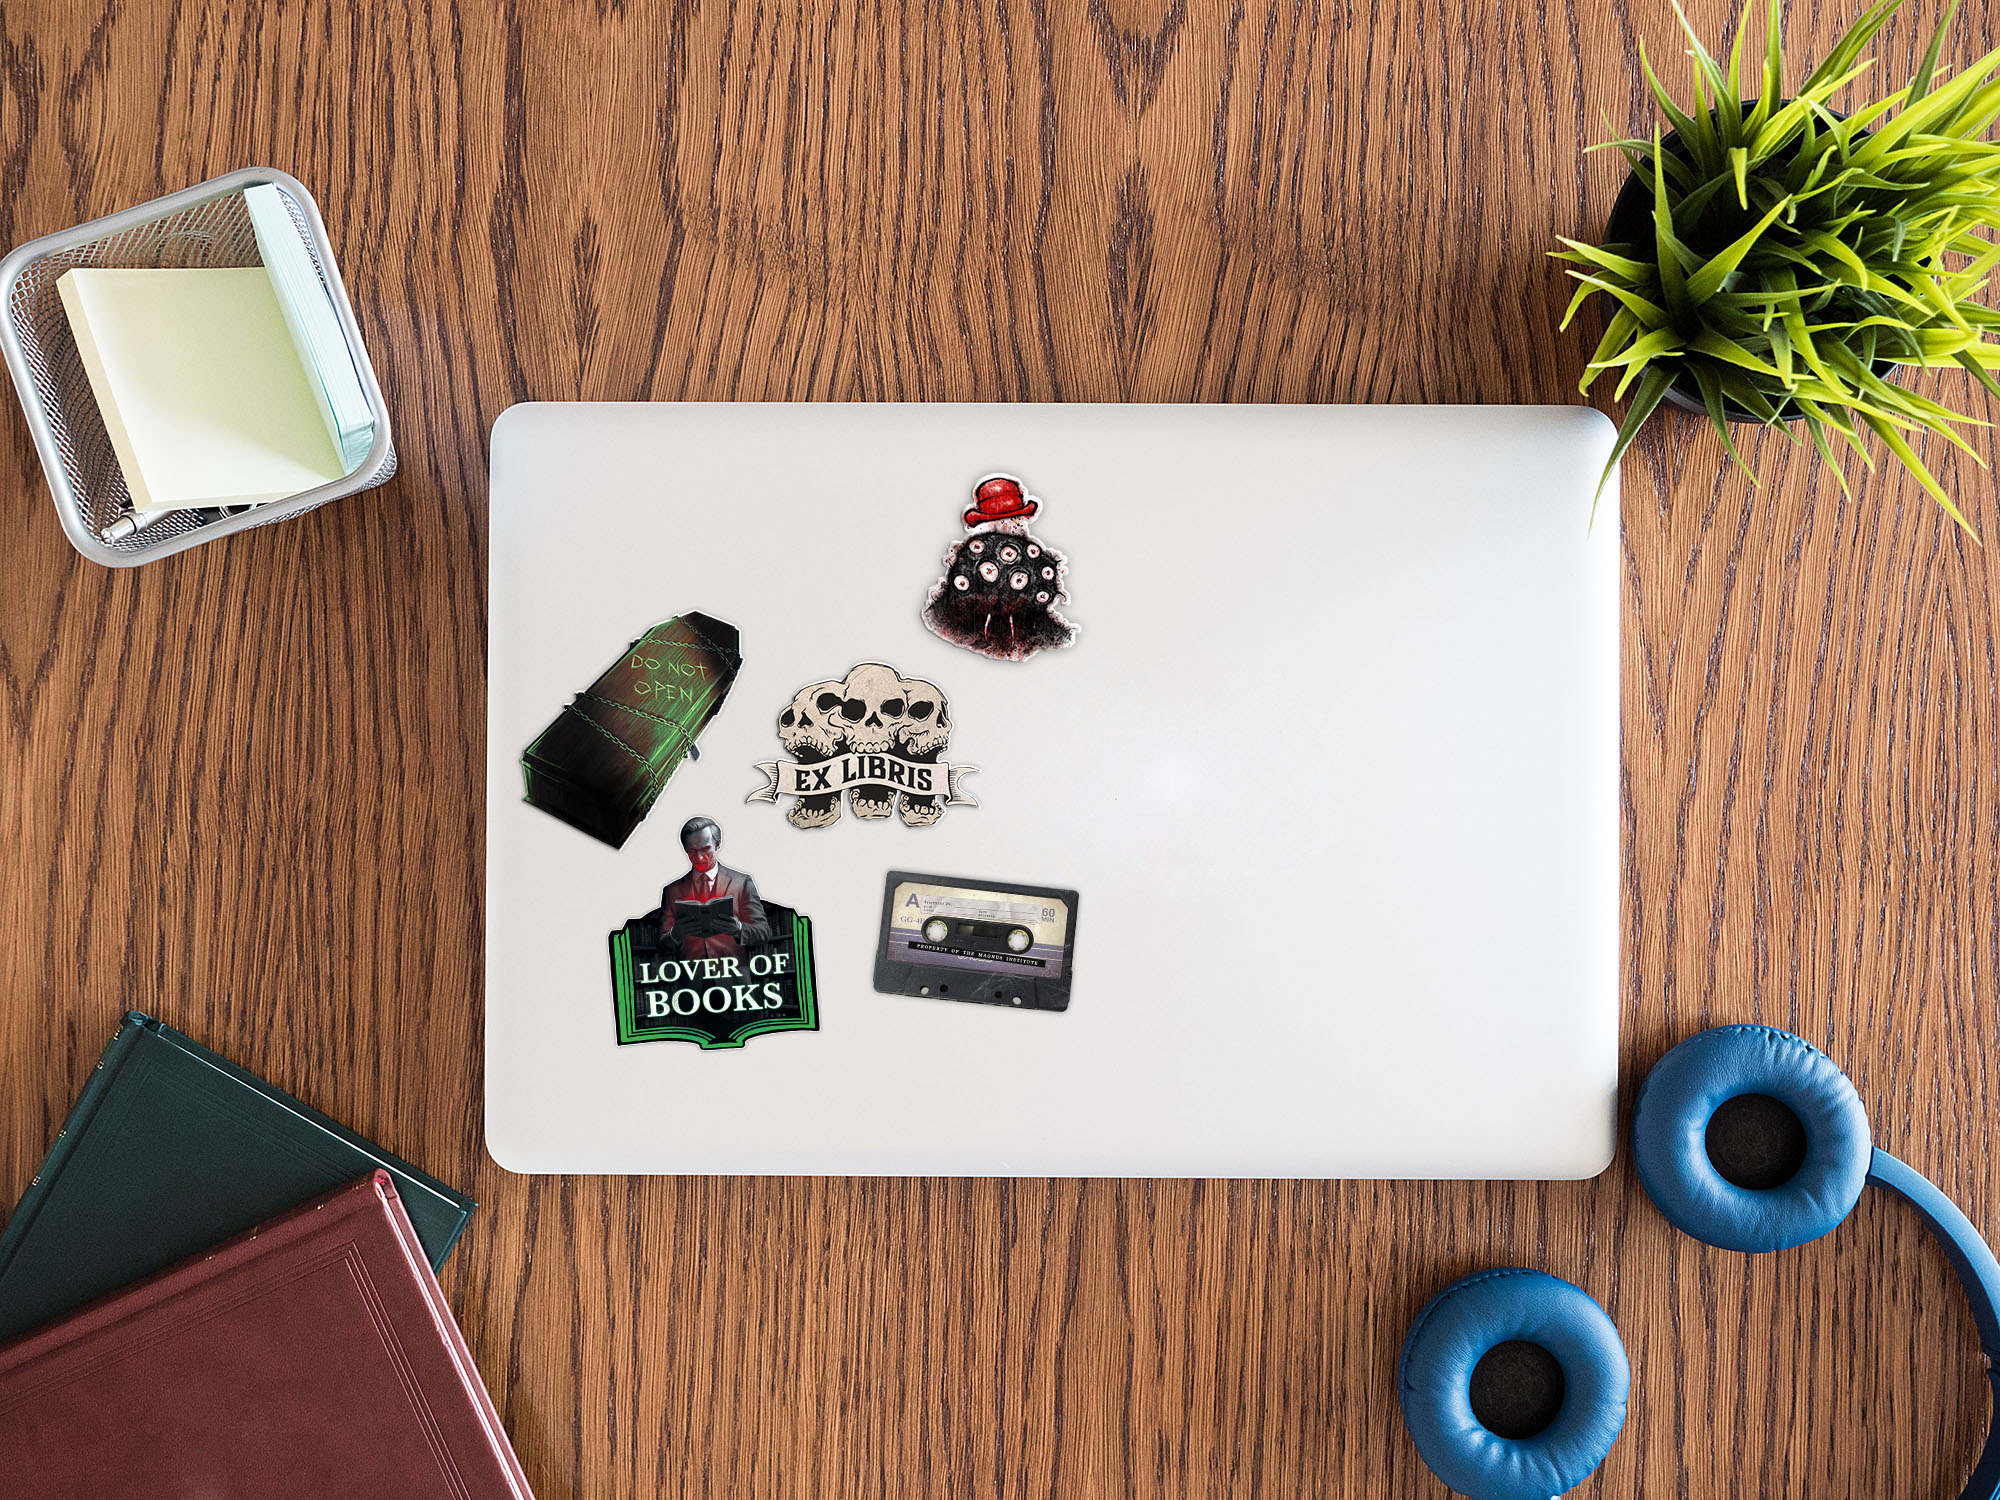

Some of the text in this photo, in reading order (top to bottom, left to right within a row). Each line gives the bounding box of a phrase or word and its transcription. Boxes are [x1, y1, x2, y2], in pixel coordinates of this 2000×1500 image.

[632, 654, 708, 680] DO NOT
[634, 680, 693, 702] OPEN
[794, 755, 932, 792] EX LIBRIS
[905, 893, 920, 908] A
[1041, 907, 1056, 918] 60
[916, 943, 948, 952] PROPERTY
[977, 952, 1003, 960] MAGNUS
[1006, 956, 1039, 966] INSTITUTE
[640, 953, 790, 984] LOVER OF
[645, 982, 783, 1018] BOOKS
